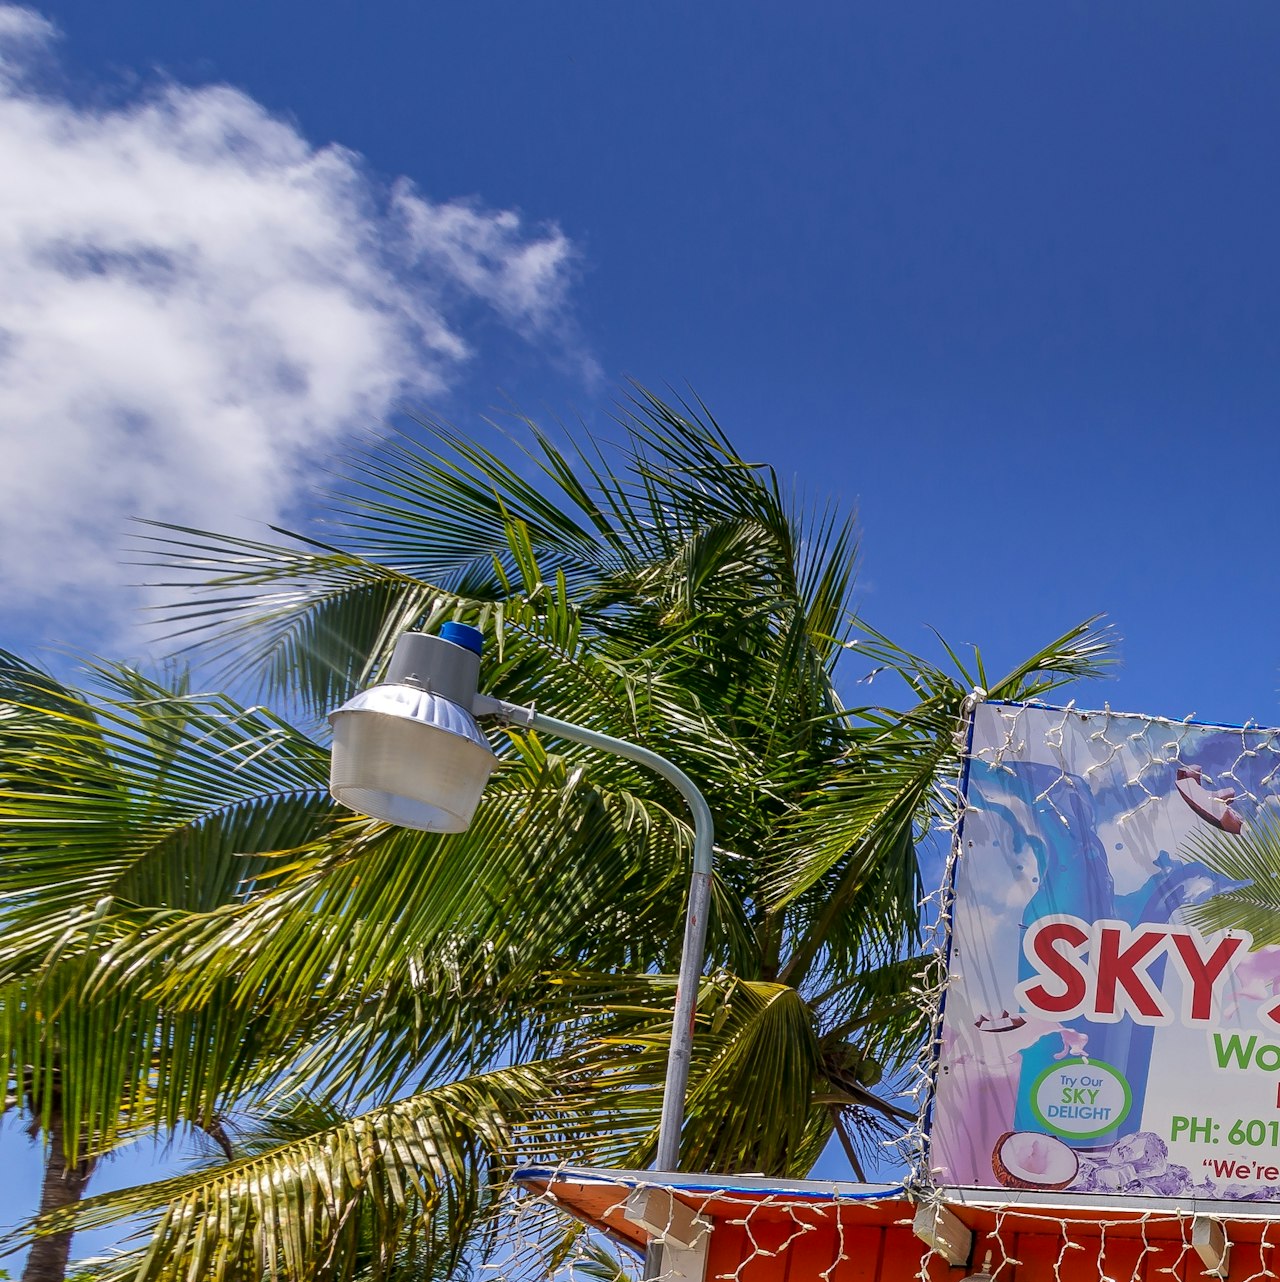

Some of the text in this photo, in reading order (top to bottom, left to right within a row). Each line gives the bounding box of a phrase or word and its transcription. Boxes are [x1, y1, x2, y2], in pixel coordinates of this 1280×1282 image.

[1024, 923, 1243, 1021] SKY
[1060, 1075, 1104, 1087] Try Our
[1061, 1088, 1100, 1105] SKY
[1047, 1105, 1111, 1120] DELIGHT
[1170, 1116, 1221, 1144] PH:
